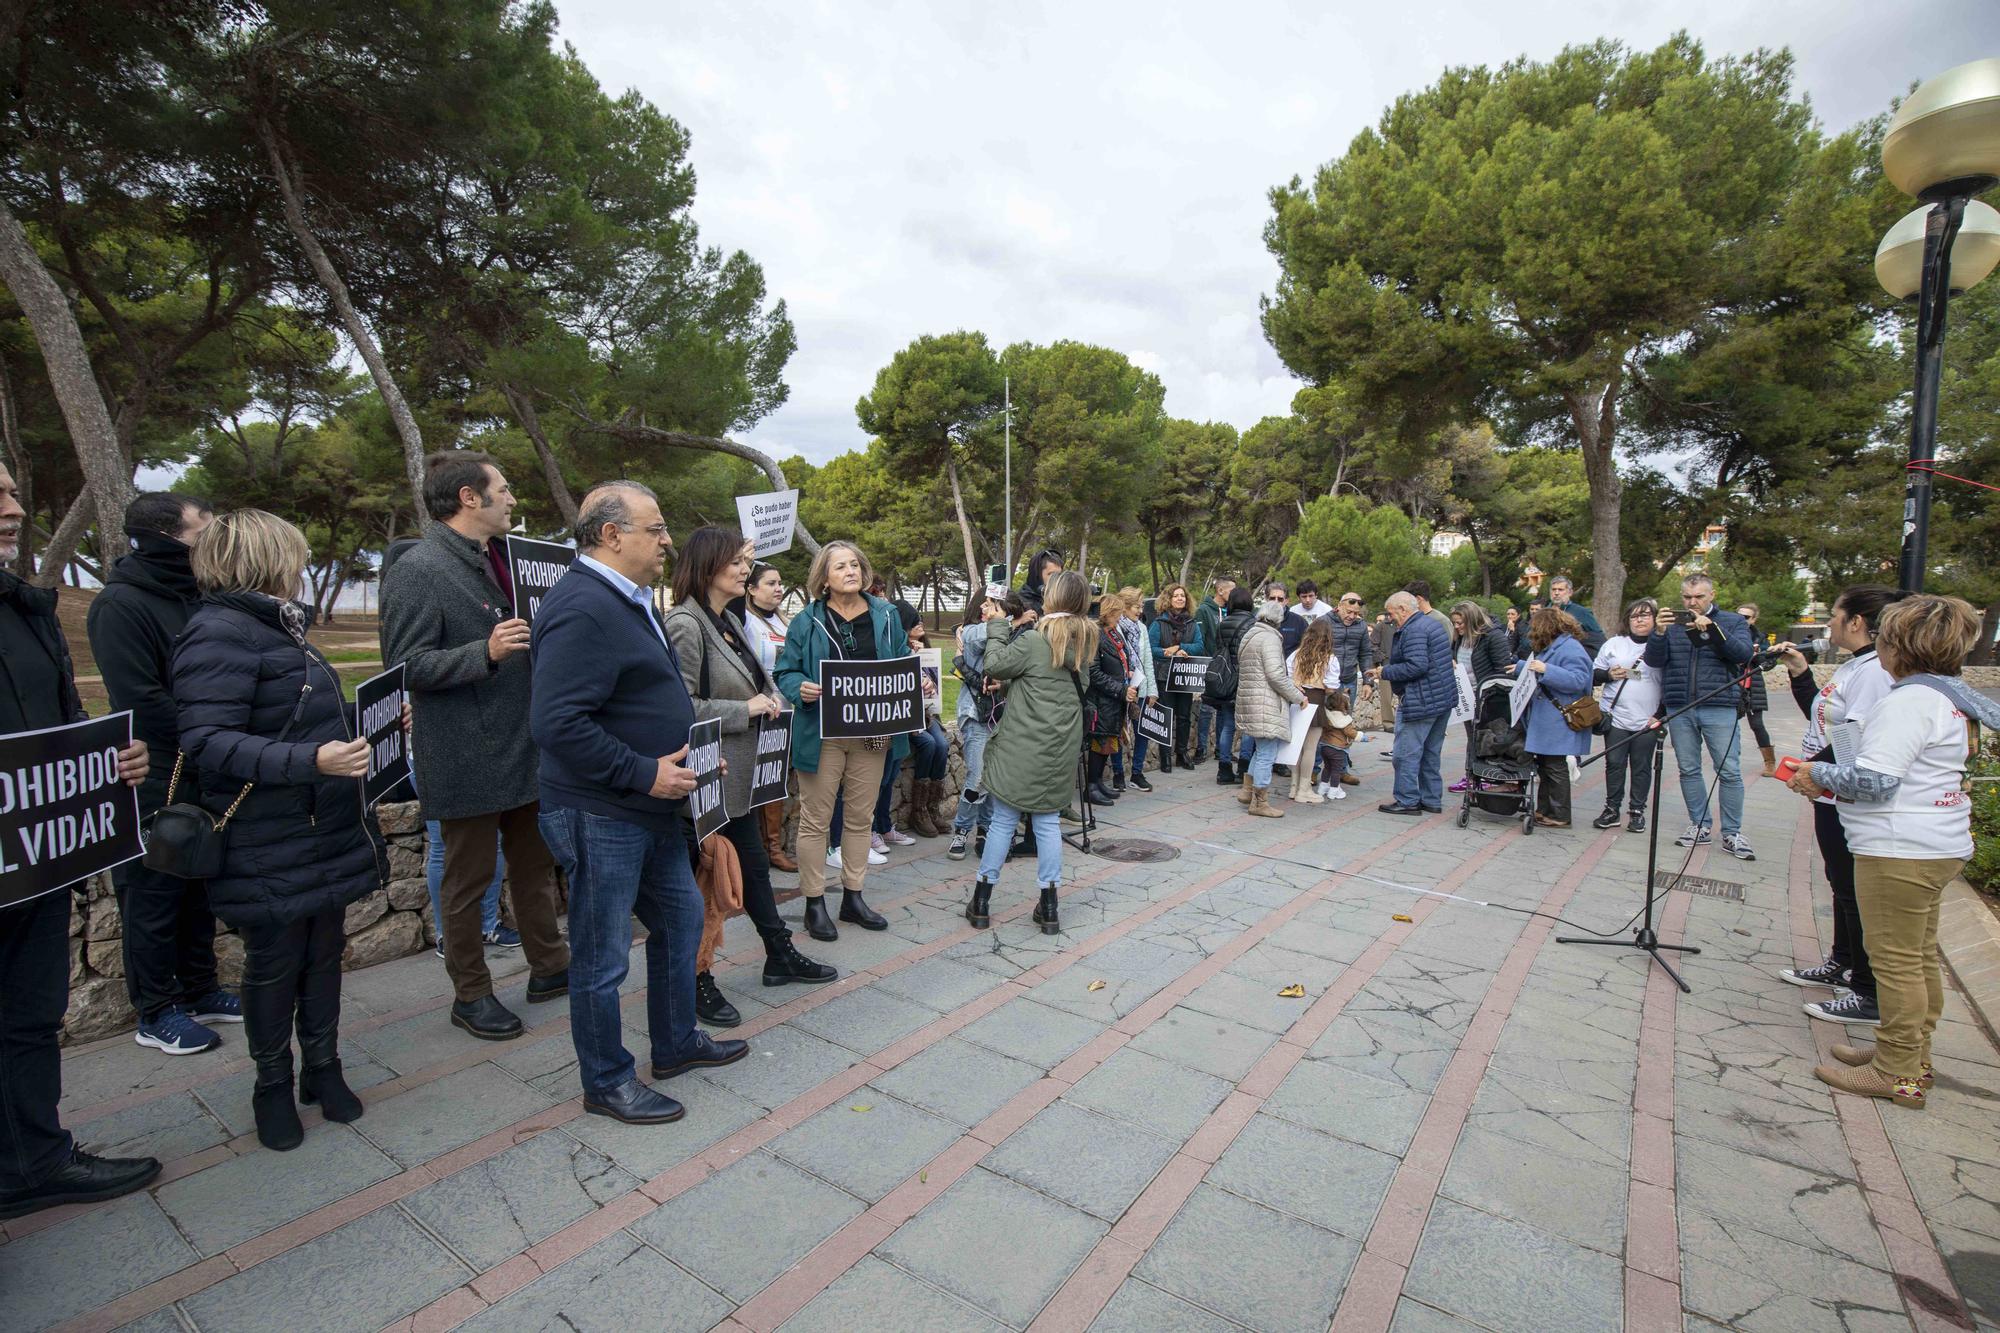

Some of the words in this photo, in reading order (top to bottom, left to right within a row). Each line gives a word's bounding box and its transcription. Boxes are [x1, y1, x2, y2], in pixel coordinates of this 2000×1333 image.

[751, 505, 763, 517] ¿Se
[765, 502, 778, 515] pudo
[779, 501, 792, 510] haber
[754, 516, 771, 527] hecho
[782, 513, 790, 523] por
[760, 527, 781, 539] encontrar
[516, 558, 570, 588] PROHIBI
[1172, 662, 1208, 674] PROHIBID
[832, 671, 916, 697] PROHIBIDO
[362, 688, 402, 739] PROHIBIDO
[842, 699, 911, 723] OLVIDAR
[1141, 717, 1168, 738] PROHIBIDO
